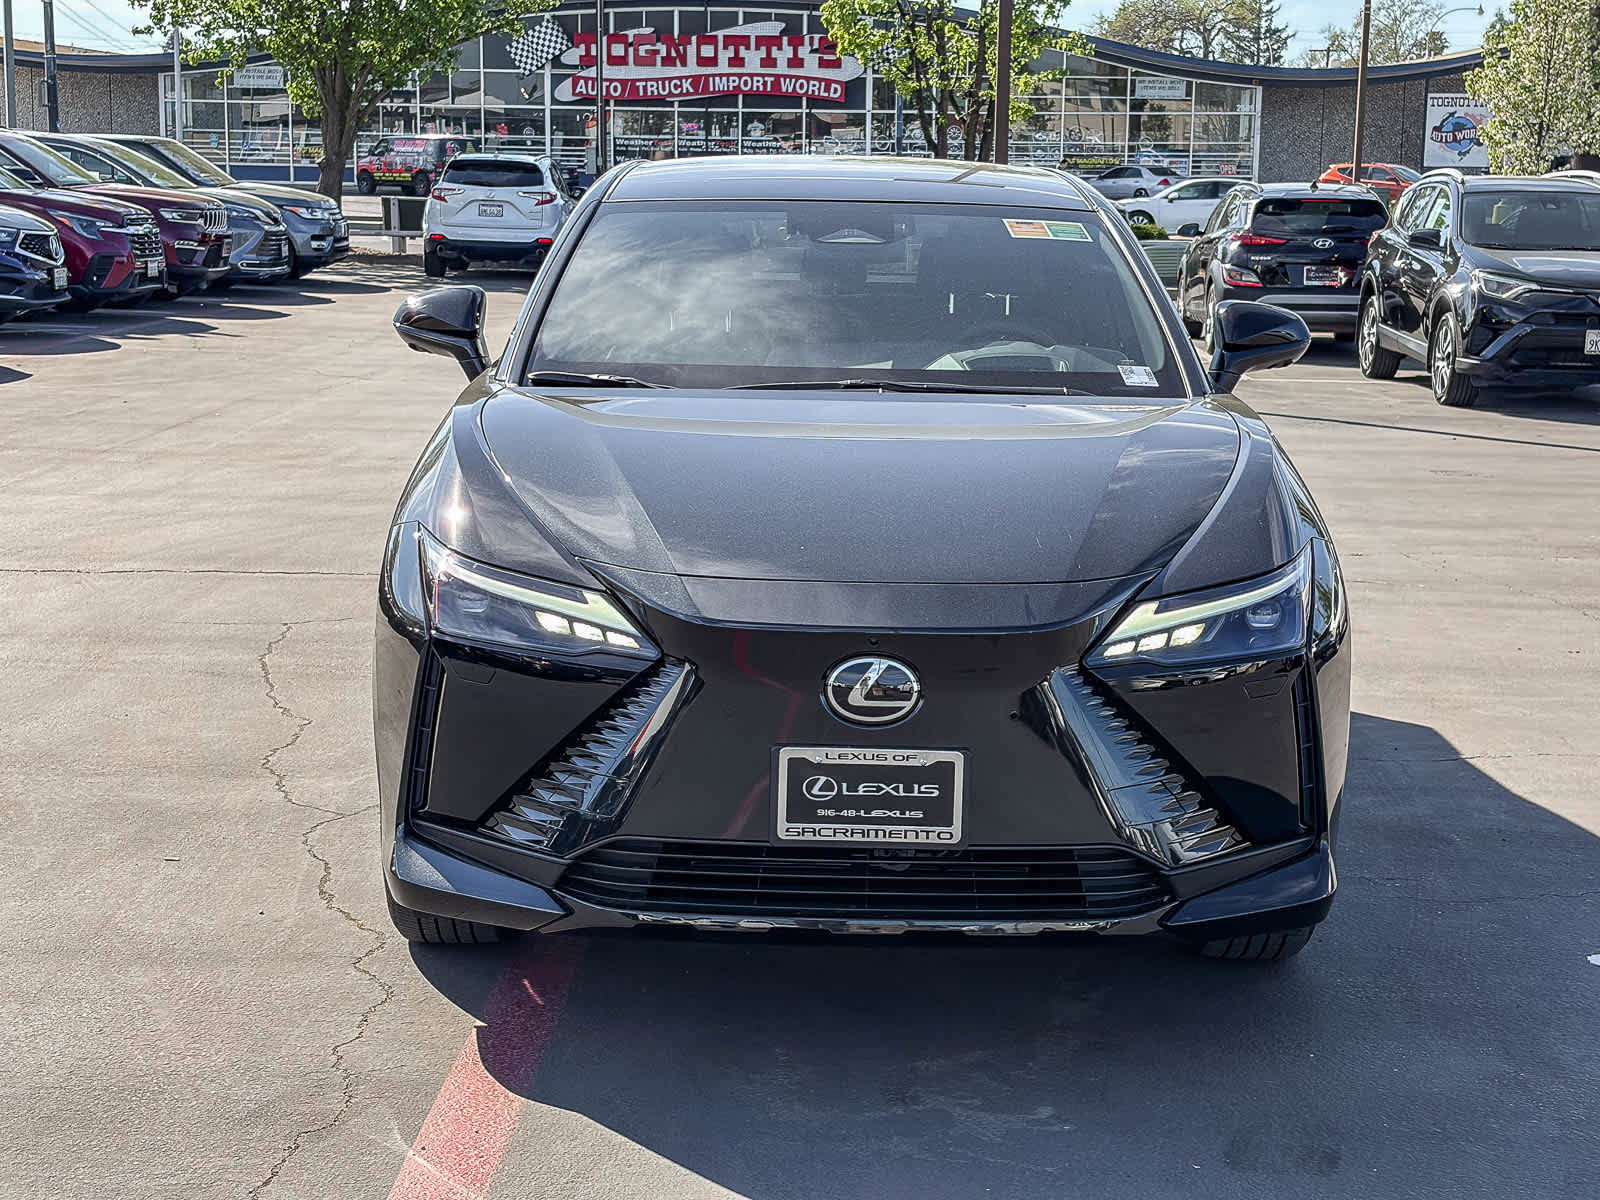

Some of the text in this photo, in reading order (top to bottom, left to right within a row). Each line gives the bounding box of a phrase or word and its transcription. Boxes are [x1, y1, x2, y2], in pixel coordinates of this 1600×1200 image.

[574, 32, 842, 68] TOGNOTTI'S
[575, 80, 622, 97] AUTO
[636, 78, 695, 96] TRUCK
[708, 76, 776, 92] IMPORT
[780, 77, 842, 98] WORLD
[1431, 131, 1453, 142] AUTO
[825, 752, 919, 762] LEXUS OF
[841, 782, 940, 797] LEXUS
[816, 808, 924, 818] 916-48-LEXUS
[784, 827, 954, 841] SACRAMENTO
